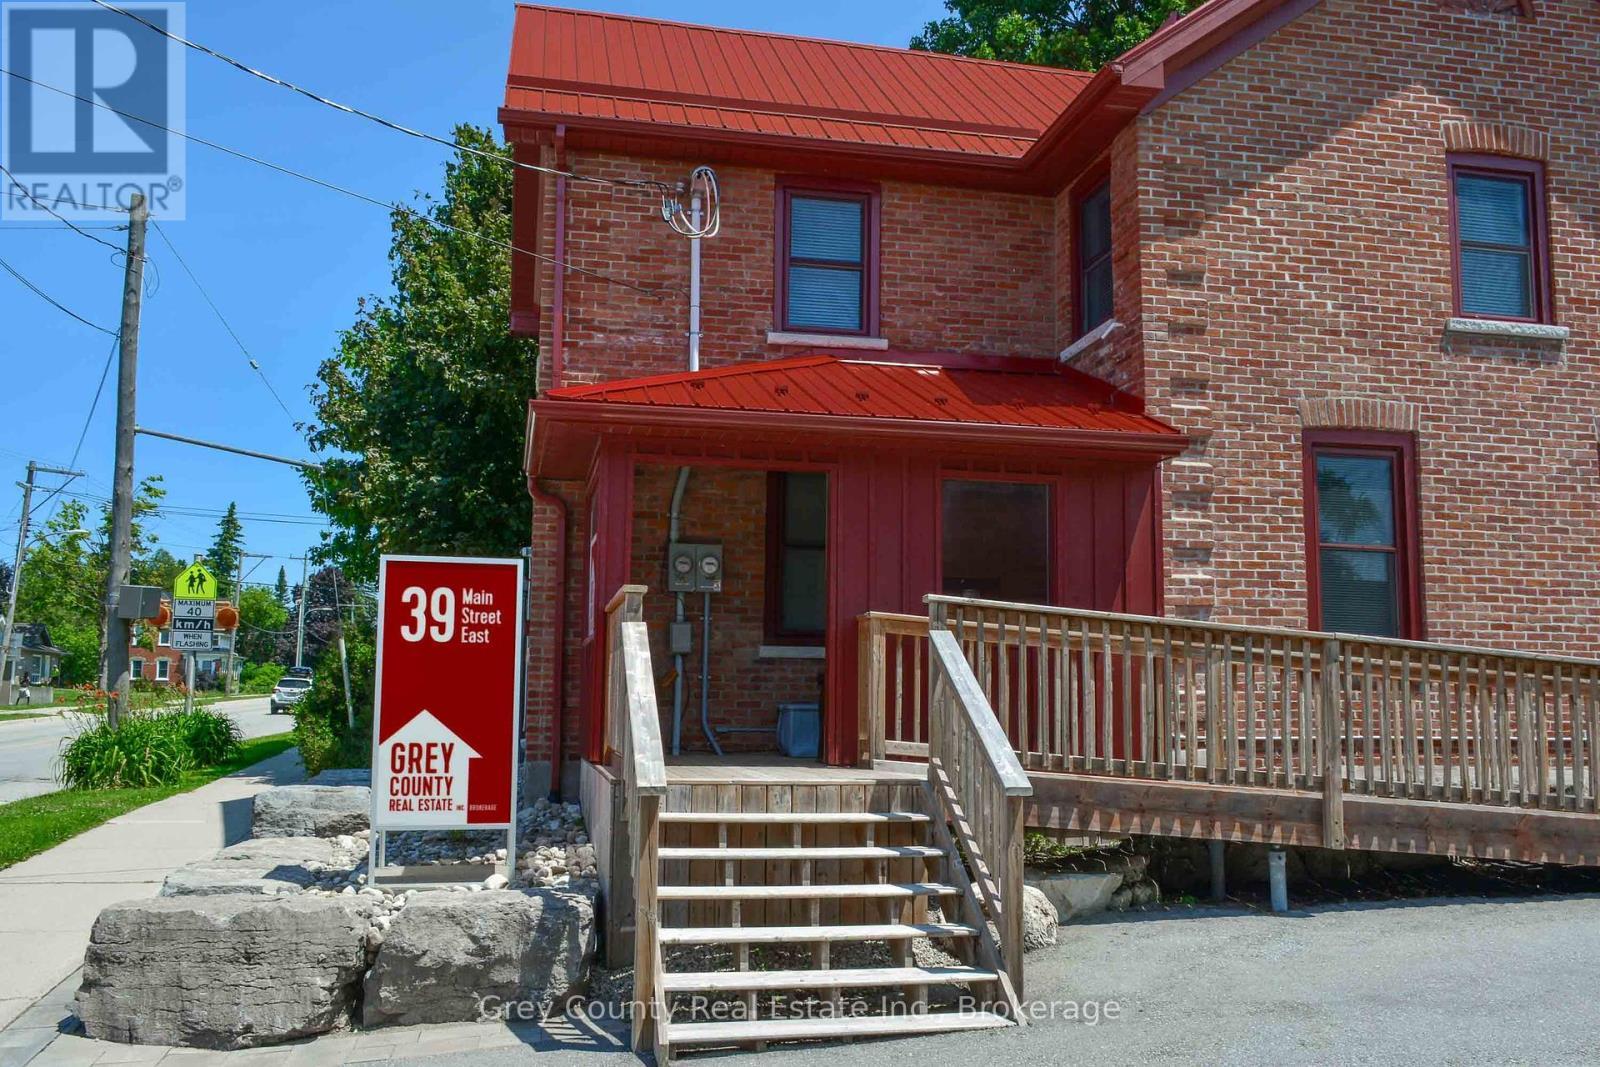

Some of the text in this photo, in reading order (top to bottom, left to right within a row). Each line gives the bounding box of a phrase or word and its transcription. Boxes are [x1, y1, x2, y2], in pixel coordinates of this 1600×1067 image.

[462, 588, 493, 605] Main
[187, 608, 202, 616] 40
[400, 586, 456, 643] 39
[461, 607, 502, 624] Street
[175, 620, 211, 629] km/h
[461, 627, 490, 643] East
[391, 742, 455, 774] GREY
[390, 776, 454, 796] COUNTY
[389, 799, 414, 812] REAL
[418, 799, 453, 812] ESTATE
